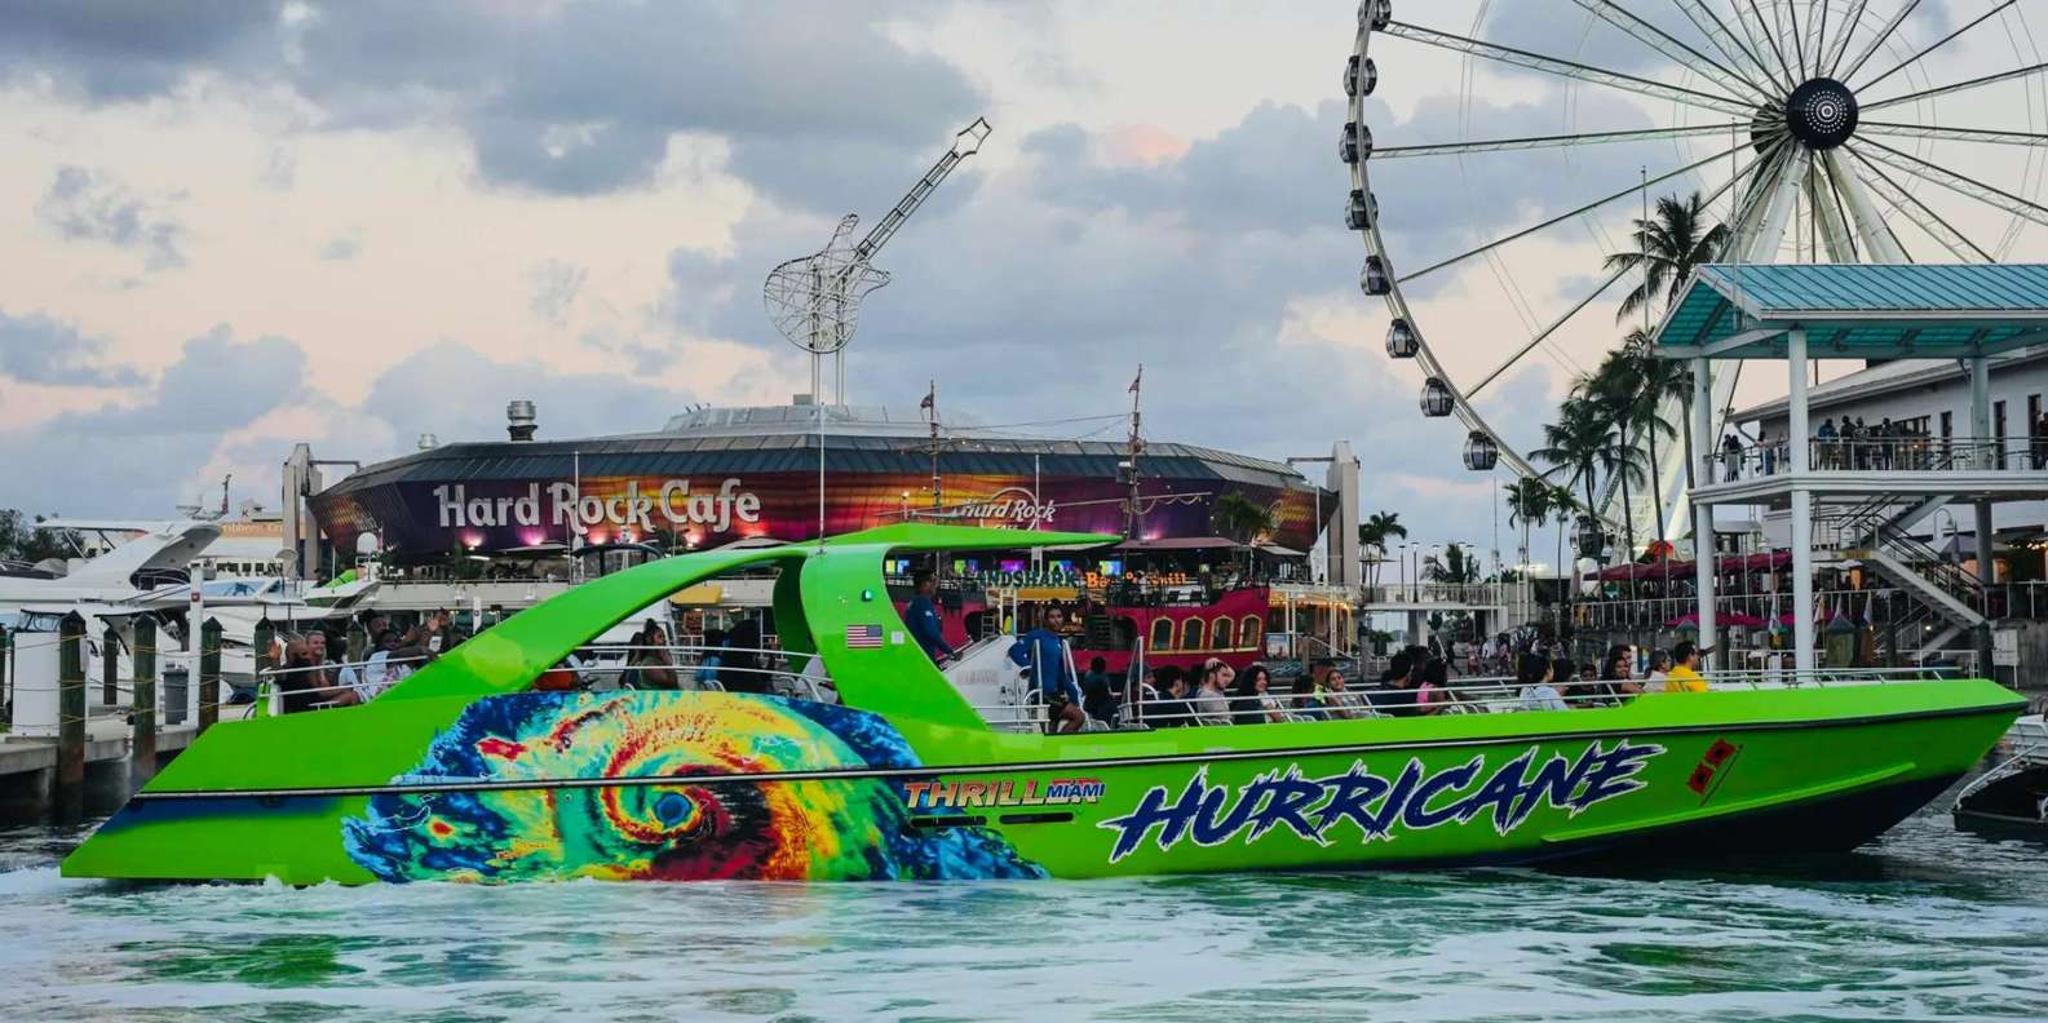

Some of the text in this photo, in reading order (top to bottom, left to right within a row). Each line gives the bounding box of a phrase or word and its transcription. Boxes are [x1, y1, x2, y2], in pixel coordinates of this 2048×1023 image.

[433, 478, 761, 534] Hard Rock Cafe
[1010, 499, 1056, 522] Rock
[1046, 783, 1106, 798] MIAMI
[1097, 738, 1667, 864] HURRICANE
